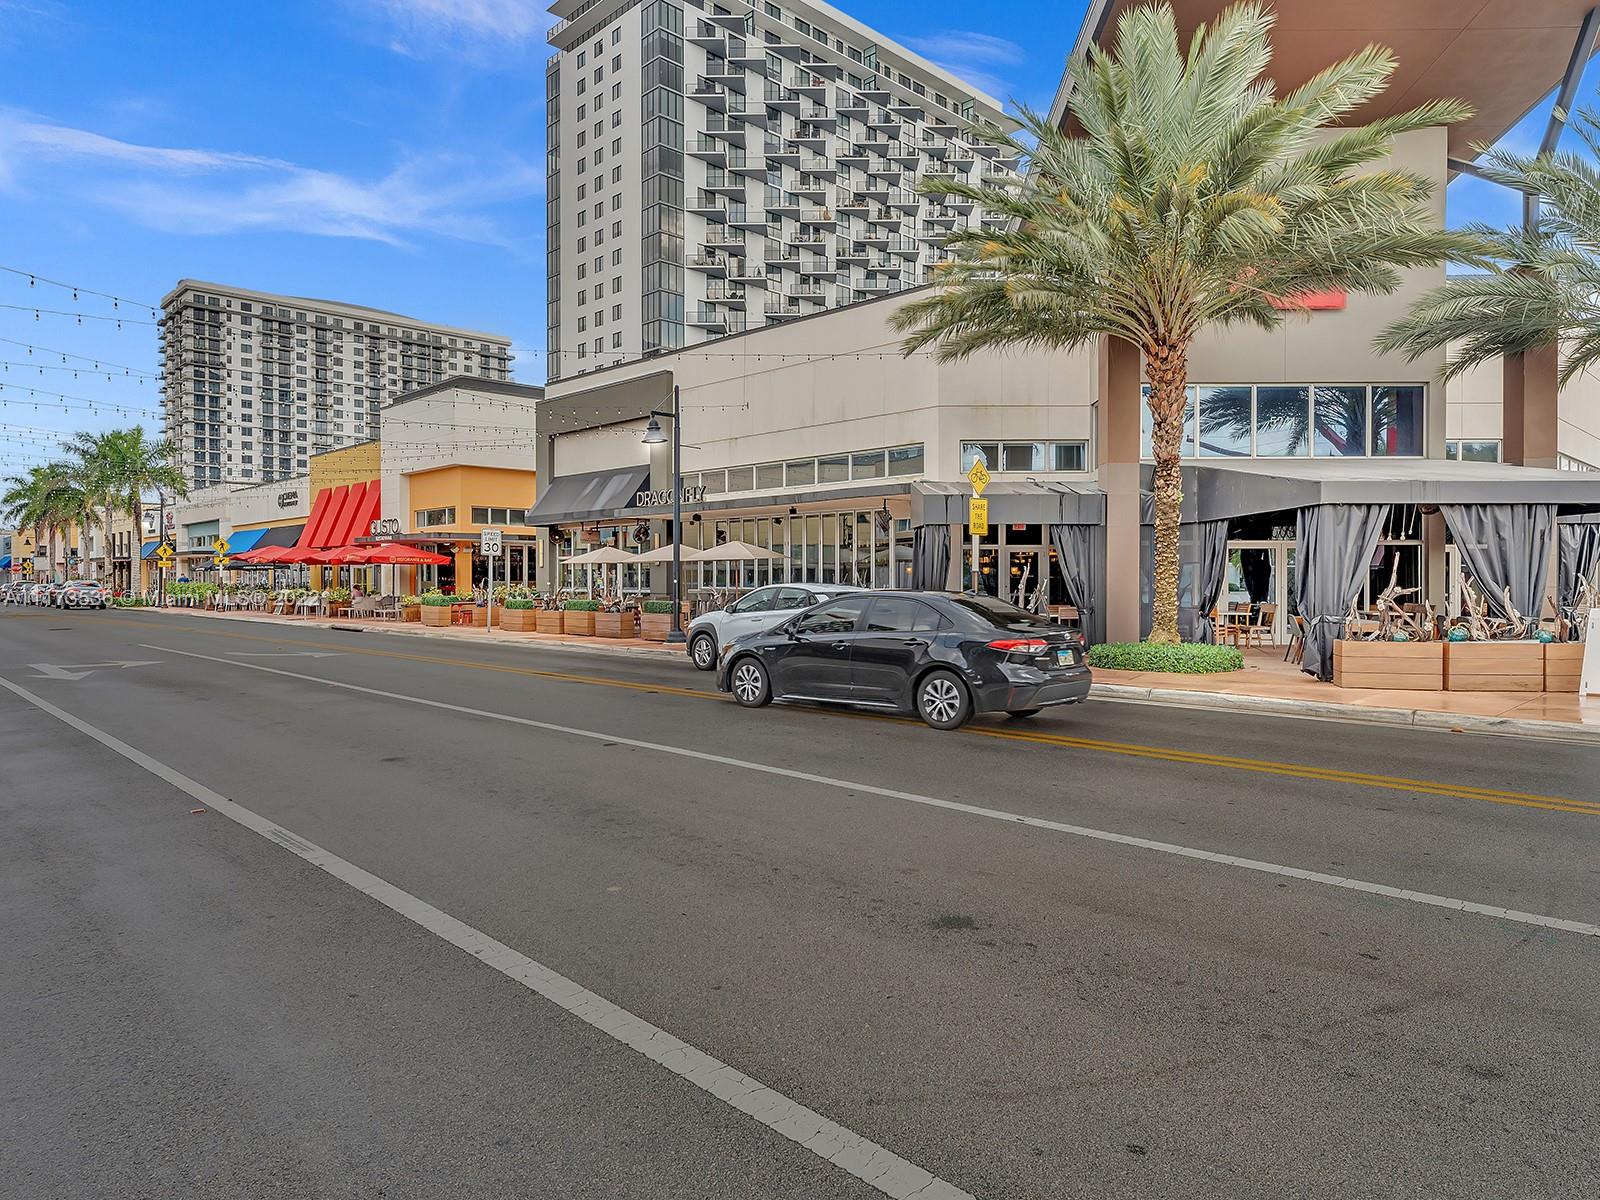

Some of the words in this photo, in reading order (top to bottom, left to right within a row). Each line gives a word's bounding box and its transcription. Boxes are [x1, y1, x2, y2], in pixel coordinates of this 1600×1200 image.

[972, 503, 986, 511] SHARE
[370, 518, 400, 536] GUSTO
[973, 522, 984, 530] ROAD
[484, 542, 499, 552] 30
